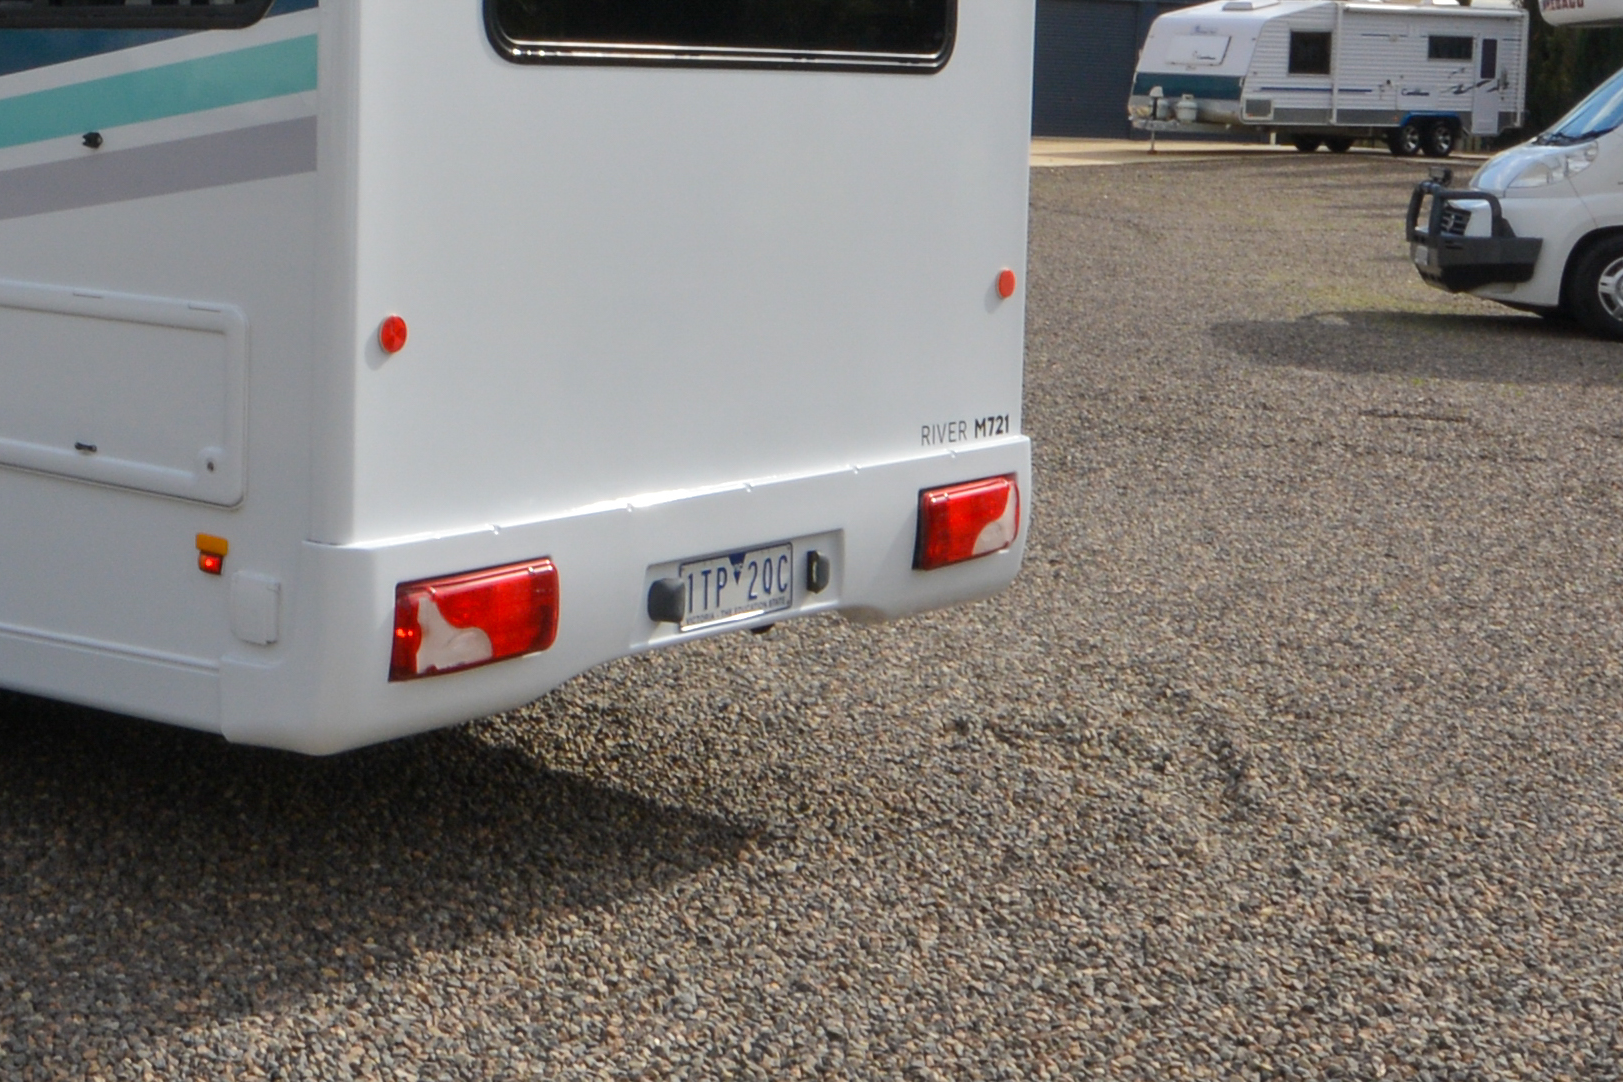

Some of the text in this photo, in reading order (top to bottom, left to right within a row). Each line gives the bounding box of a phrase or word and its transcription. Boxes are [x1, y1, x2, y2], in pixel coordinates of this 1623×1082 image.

[921, 414, 1009, 446] RIVER M721
[688, 555, 788, 613] 1TP 2QC
